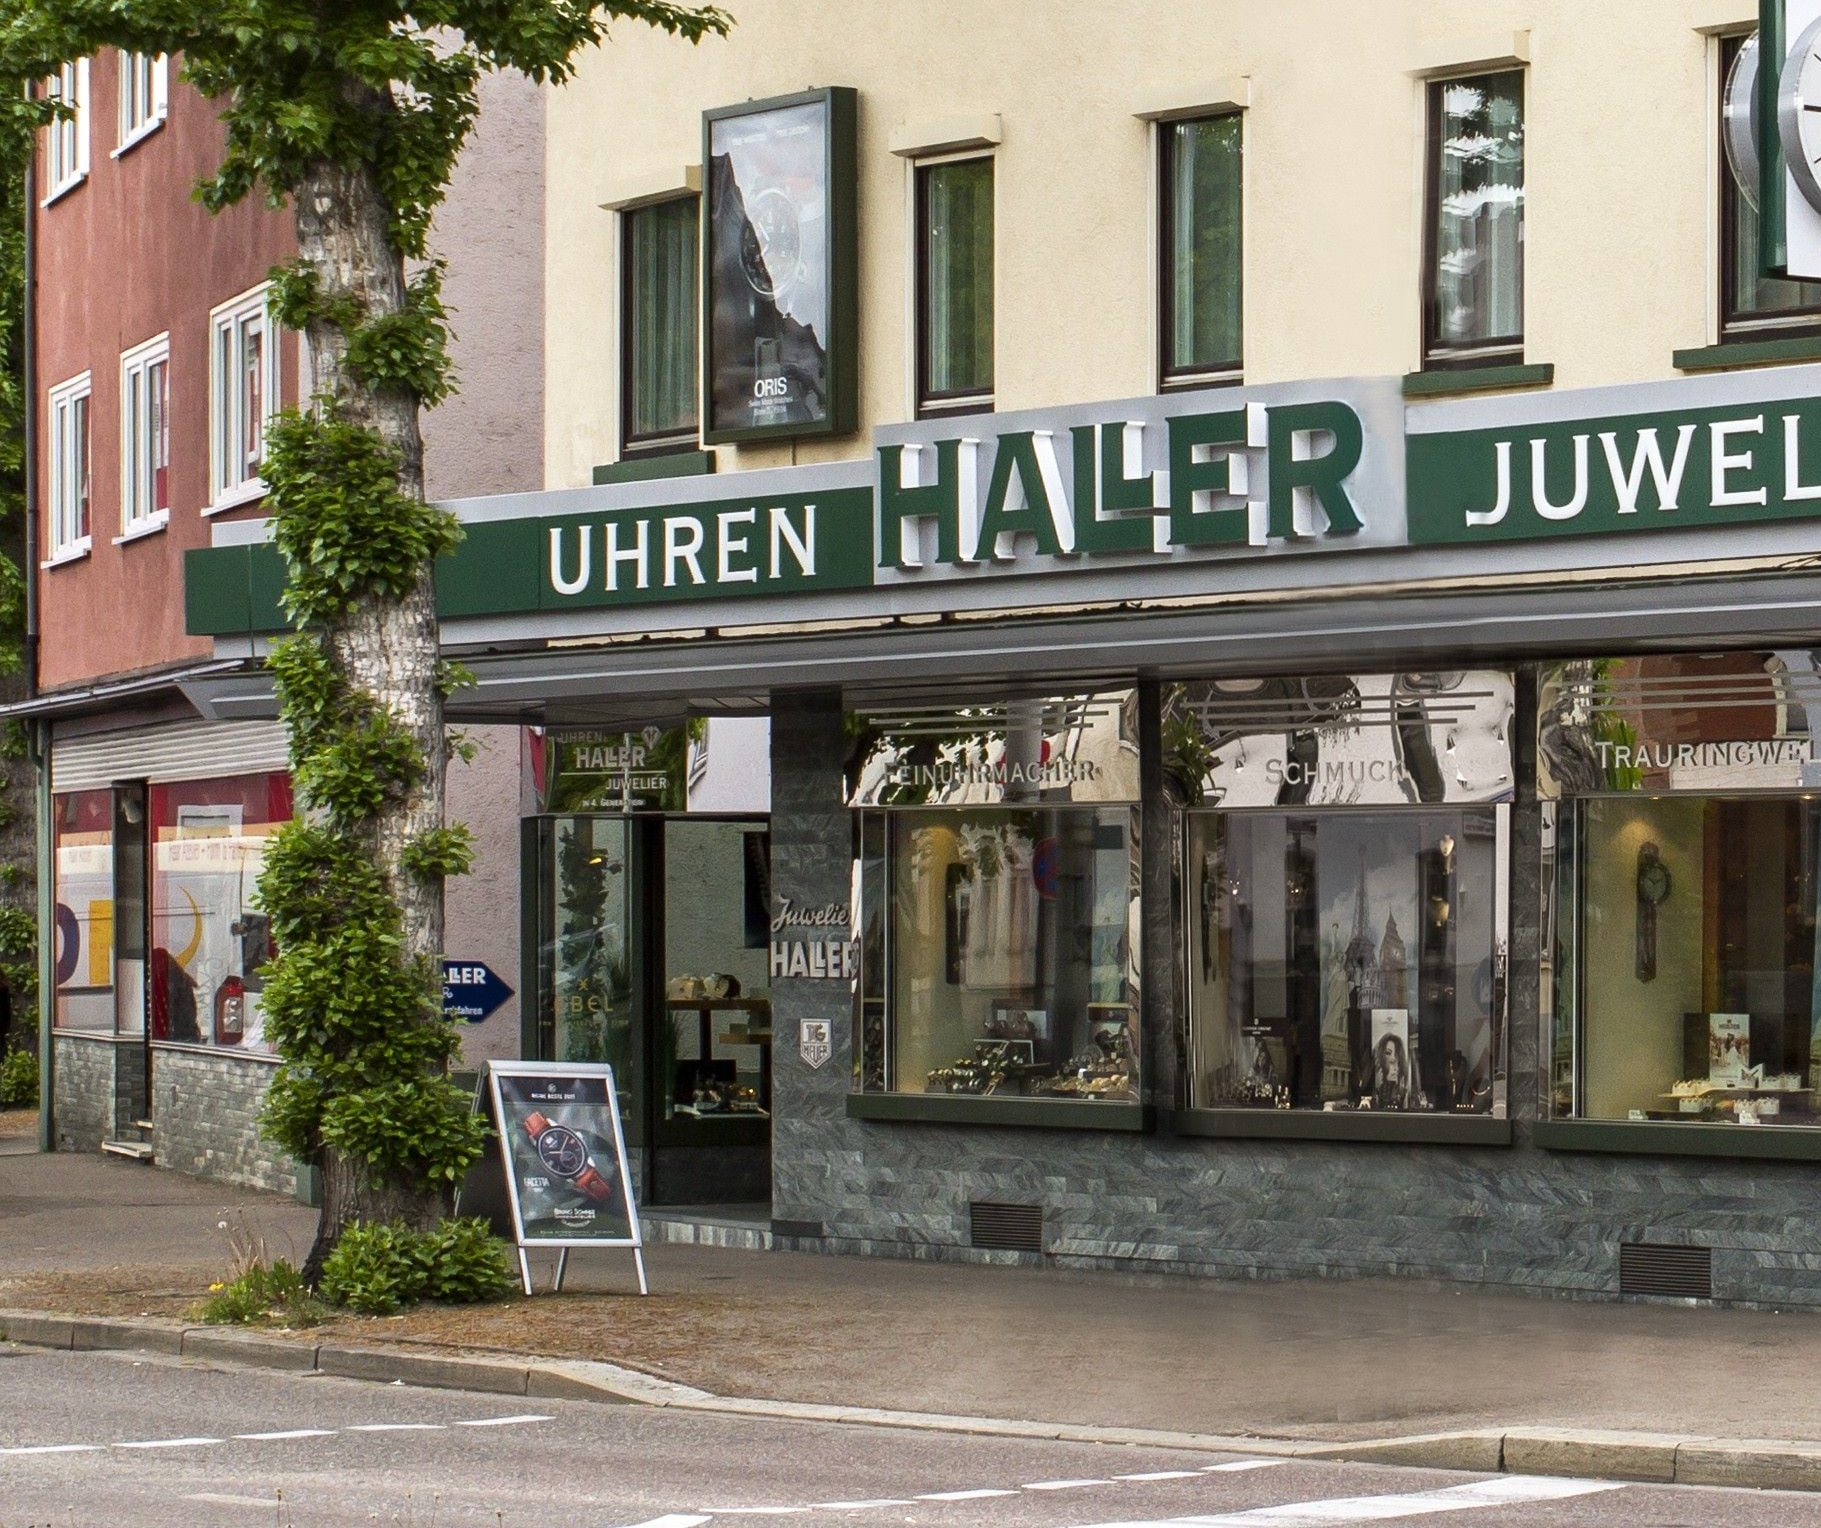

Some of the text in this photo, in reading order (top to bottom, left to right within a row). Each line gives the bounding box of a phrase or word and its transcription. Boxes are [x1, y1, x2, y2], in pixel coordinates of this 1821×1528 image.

[754, 376, 787, 397] ORIS
[549, 505, 817, 595] UHREN
[877, 400, 1365, 568] HALLER
[575, 746, 646, 769] HALLER
[606, 777, 668, 790] JUWELIER
[884, 760, 1097, 786] FEINUHRMACHER
[1264, 758, 1404, 784] SCHMUCK
[771, 896, 849, 933] Juwelie
